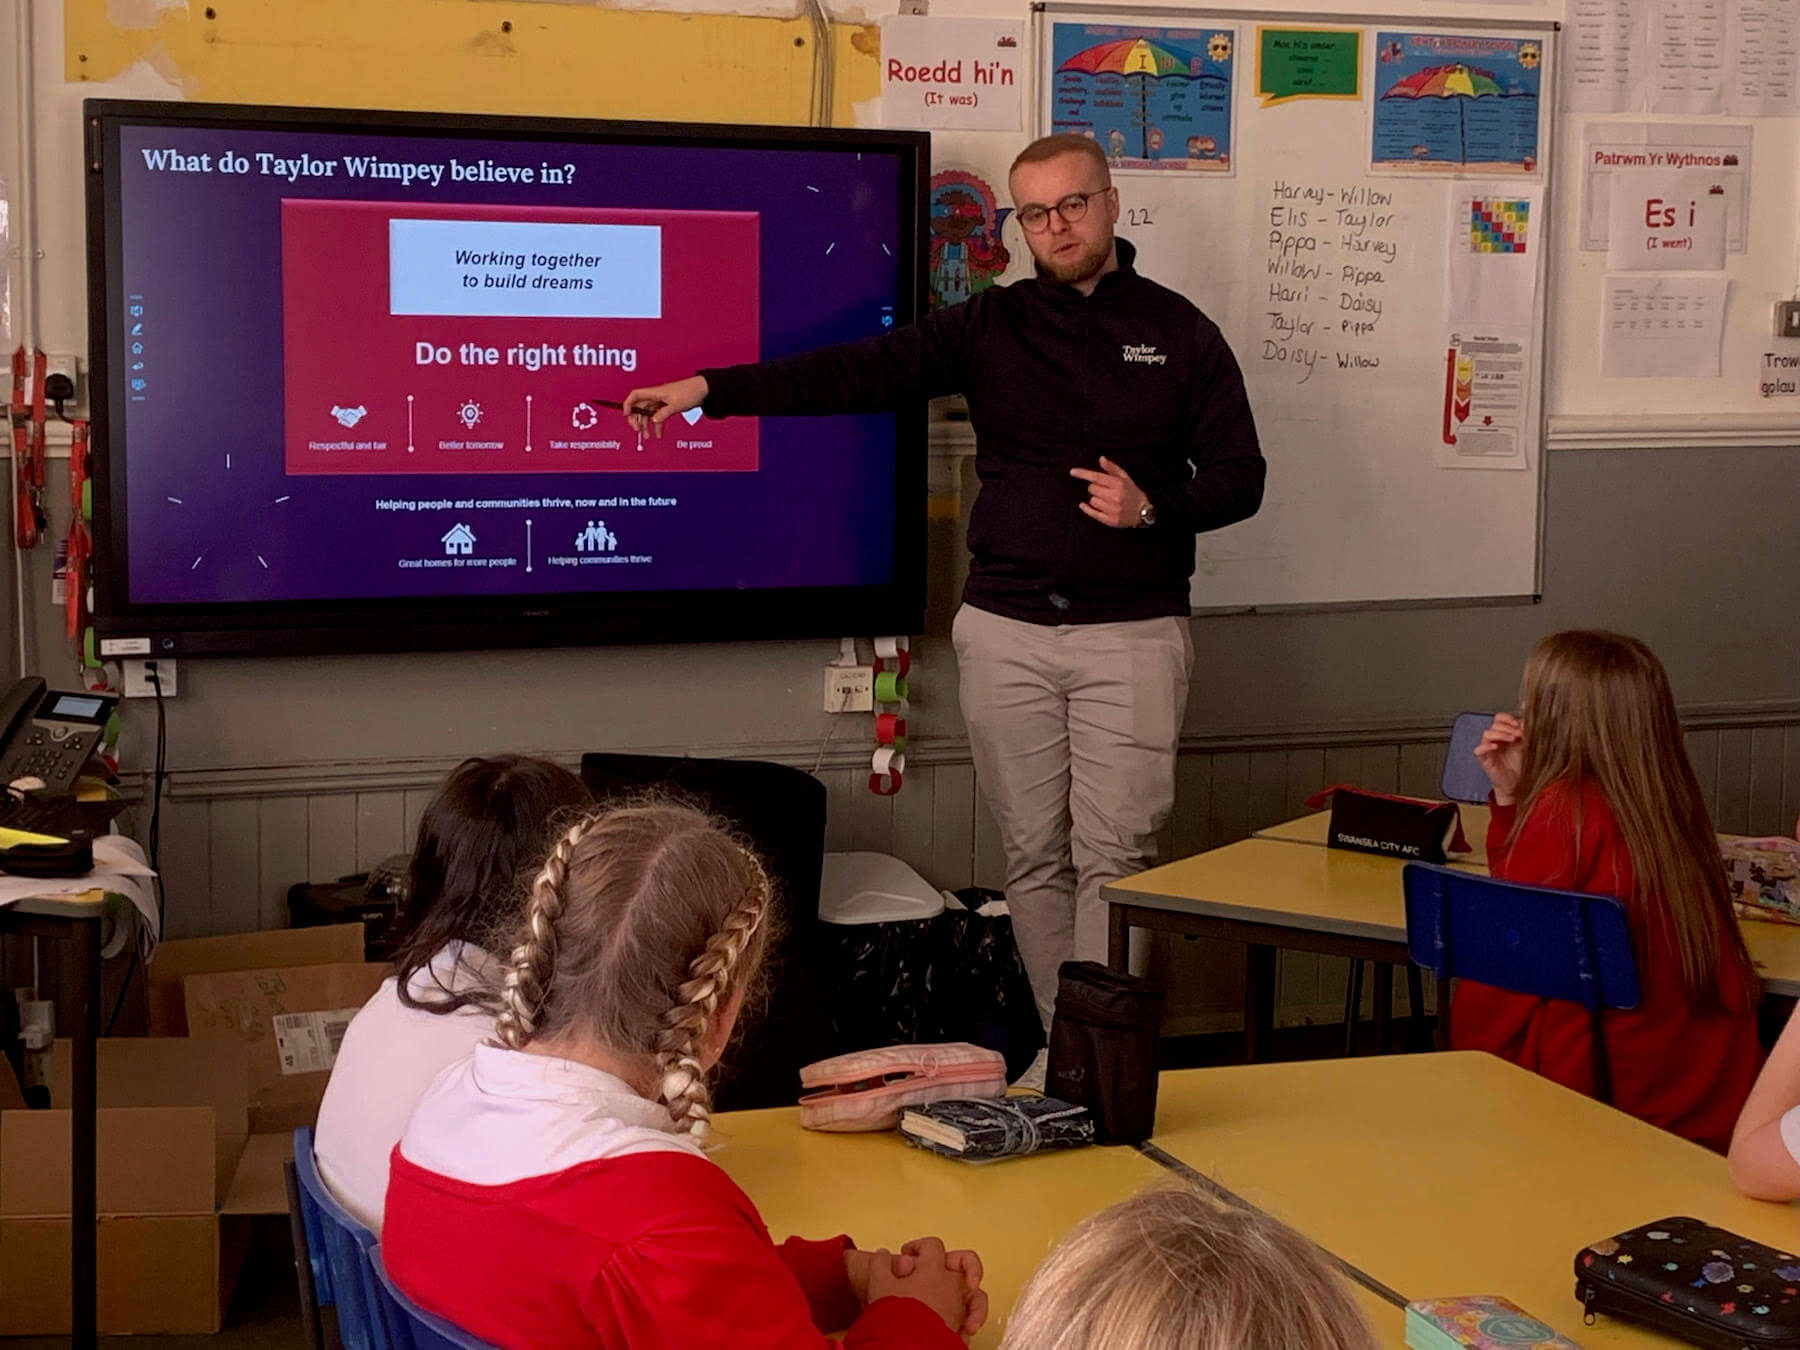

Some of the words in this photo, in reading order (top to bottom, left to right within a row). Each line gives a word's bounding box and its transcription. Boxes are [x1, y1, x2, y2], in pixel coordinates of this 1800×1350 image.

[888, 58, 961, 83] Roedd
[974, 60, 1014, 85] hi'n
[924, 92, 943, 107] (It
[949, 92, 978, 108] was)
[141, 148, 211, 173] What
[218, 151, 249, 174] do
[255, 152, 337, 183] Taylor
[343, 156, 444, 186] Wimpey
[450, 158, 533, 185] believe
[540, 163, 576, 185] in?
[1594, 151, 1646, 165] Patrwm
[1648, 153, 1664, 165] Yr
[1666, 152, 1721, 168] Wythnos
[1273, 180, 1324, 205] Harvey
[1341, 186, 1392, 206] Willow
[1128, 208, 1154, 226] 22
[1270, 207, 1308, 227] Elis
[1336, 209, 1395, 236] Taylor
[1645, 199, 1676, 228] Es
[1689, 201, 1696, 227] i
[1269, 230, 1316, 257] Pippa
[1342, 234, 1397, 264] Harvey
[1647, 237, 1658, 251] (I
[1662, 237, 1693, 251] went)
[455, 249, 525, 270] Working
[531, 252, 602, 271] together
[1267, 255, 1321, 280] Willow
[1342, 265, 1385, 287] Pippa
[462, 273, 478, 289] to
[483, 272, 527, 290] build
[531, 275, 593, 291] dreams
[1269, 283, 1309, 302] Harri
[1339, 292, 1382, 324] Daisy
[1267, 312, 1315, 341] Taylor
[1342, 320, 1375, 336] Pippa
[416, 342, 451, 366] Do
[459, 343, 499, 366] the
[506, 344, 567, 371] right
[573, 344, 637, 372] thing
[1122, 343, 1157, 355] Taylor
[1123, 353, 1168, 365] Wimpey
[1336, 352, 1380, 369] Willow
[1761, 377, 1796, 398] golau
[439, 441, 464, 450] Better
[465, 441, 504, 450] tomorrow
[550, 440, 568, 449] Take
[570, 440, 621, 451] responsibility
[677, 440, 688, 449] Be
[689, 440, 713, 451] proud
[376, 499, 416, 511] Helping
[418, 499, 453, 511] people
[454, 499, 474, 509] and
[476, 498, 540, 508] communities
[542, 498, 574, 509] thrive,
[575, 499, 597, 507] now
[598, 497, 617, 507] and
[619, 497, 629, 506] in
[631, 497, 646, 506] the
[648, 497, 677, 506] future
[398, 559, 422, 568] Great
[424, 559, 452, 567] homes
[453, 558, 465, 567] for
[466, 559, 488, 567] more
[489, 558, 517, 568] people
[548, 556, 578, 566] Helping
[579, 556, 629, 564] communities
[630, 555, 652, 564] thrive
[1337, 832, 1379, 849] SWANSEA
[1380, 841, 1401, 852] CITY
[1401, 845, 1420, 856] AFC
